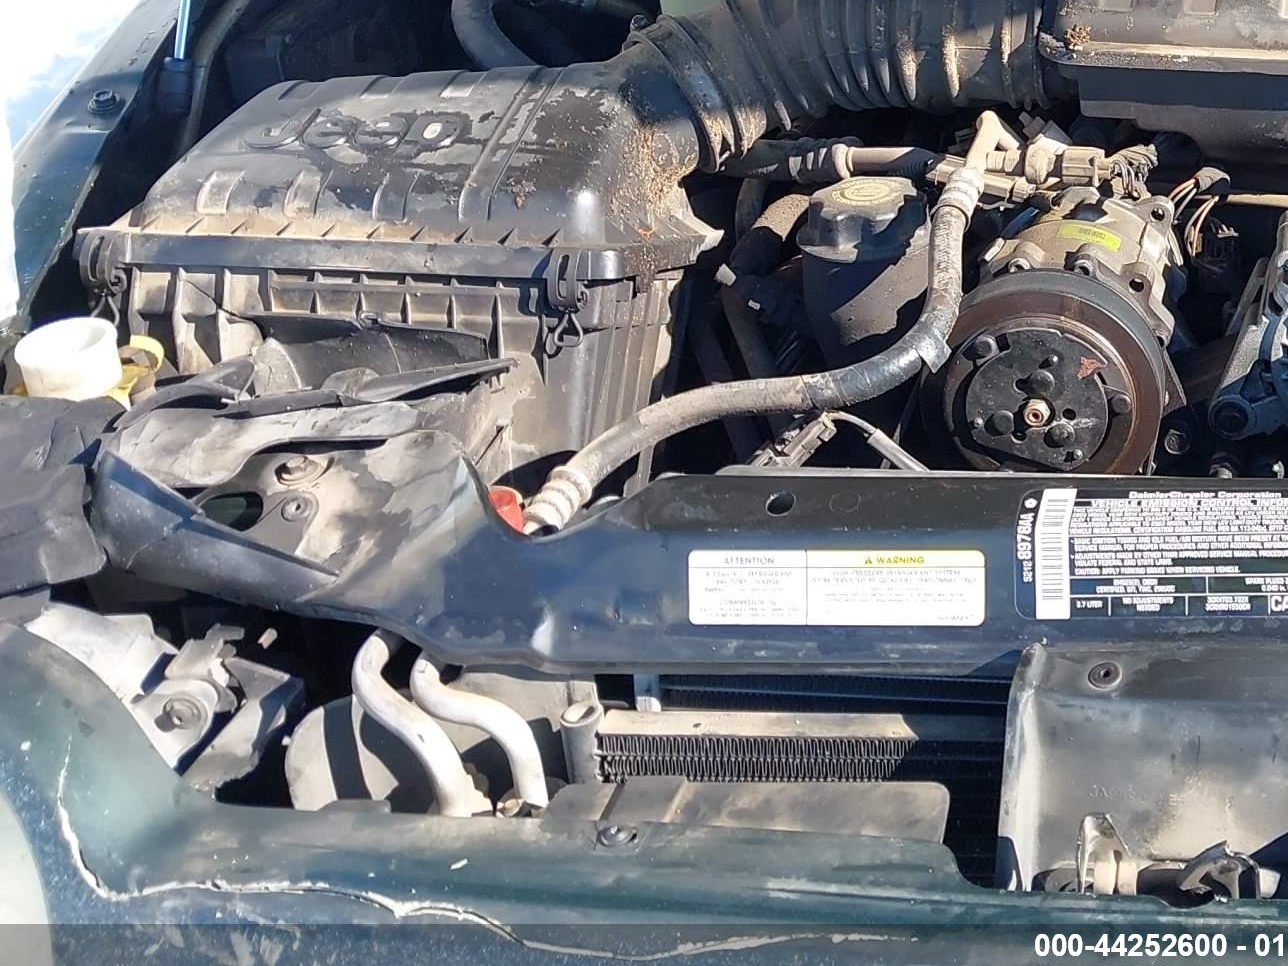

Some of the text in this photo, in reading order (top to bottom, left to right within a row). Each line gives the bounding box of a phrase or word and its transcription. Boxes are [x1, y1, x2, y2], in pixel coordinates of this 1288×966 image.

[244, 108, 466, 158] Jeep
[1129, 491, 1216, 499] DaimlerChrysler
[1141, 499, 1198, 507] EMISSION
[1200, 499, 1255, 507] CONTROL
[724, 556, 774, 565] ATTENTION
[876, 556, 924, 564] WARNING
